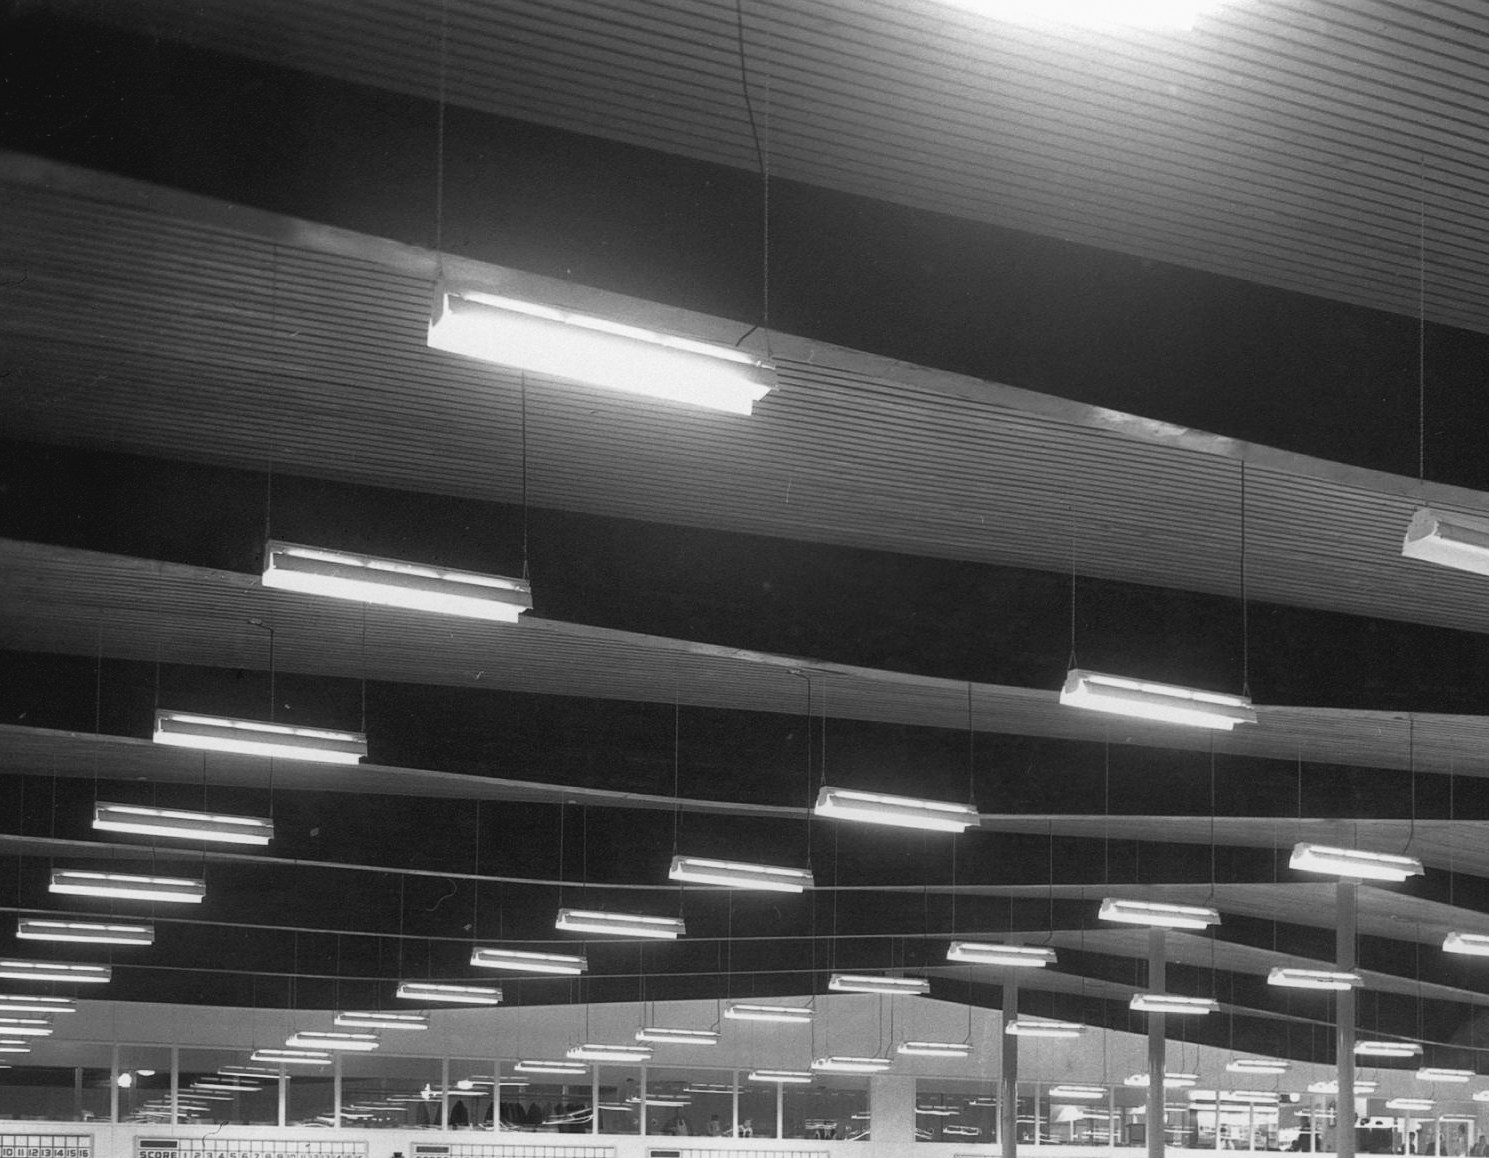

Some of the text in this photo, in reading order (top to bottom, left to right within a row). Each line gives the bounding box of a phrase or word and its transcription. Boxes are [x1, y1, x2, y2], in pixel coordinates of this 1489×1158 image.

[3, 1148, 13, 1156] 10
[41, 1149, 51, 1157] 13
[54, 1149, 64, 1157] 14
[66, 1149, 76, 1157] 15
[79, 1149, 88, 1158] 16
